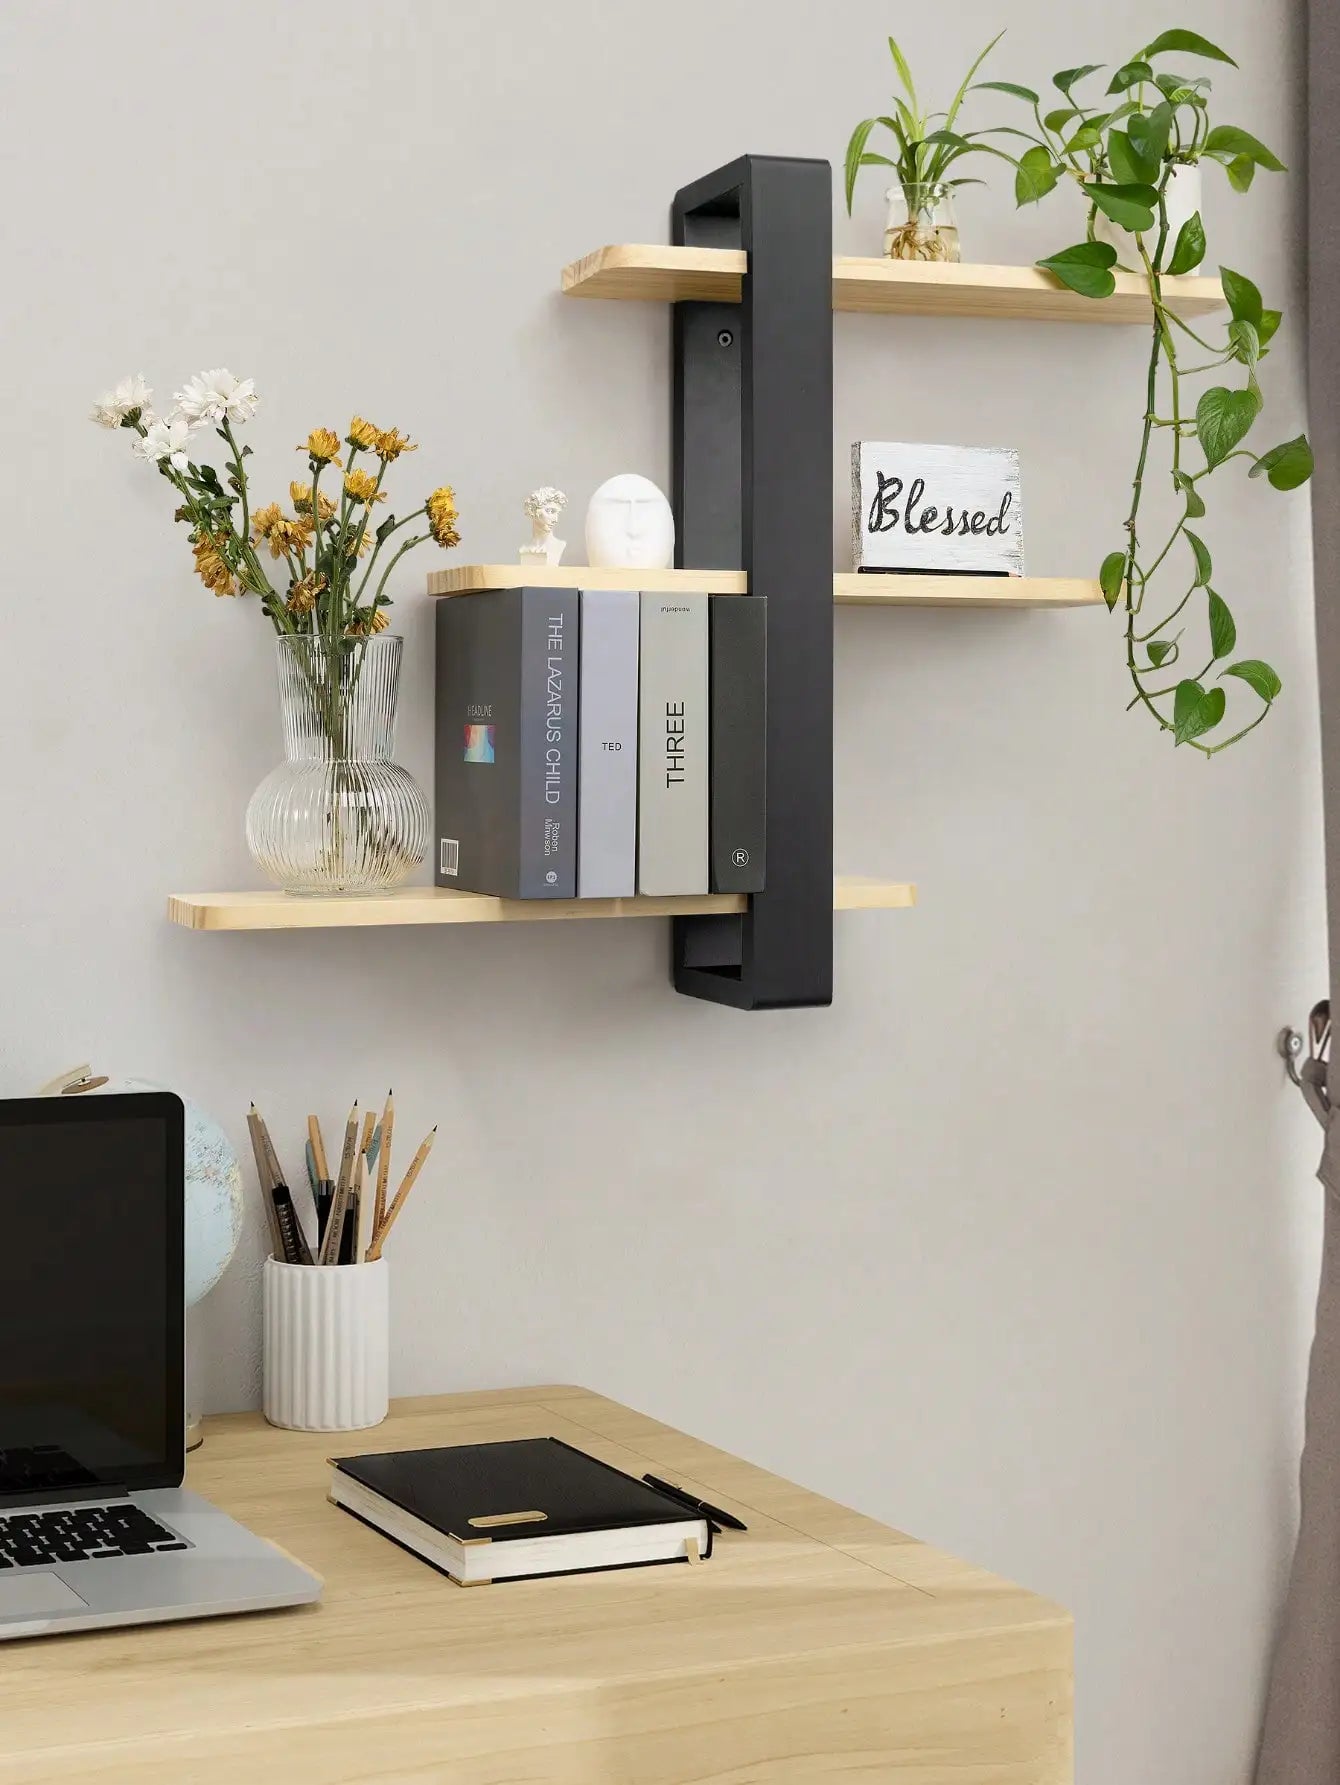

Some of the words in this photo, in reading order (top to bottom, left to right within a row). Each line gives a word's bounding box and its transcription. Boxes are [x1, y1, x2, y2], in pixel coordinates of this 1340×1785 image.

[868, 471, 1012, 536] Blessed
[548, 613, 563, 651] THE
[546, 657, 562, 743] LAZARUS
[602, 743, 622, 751] TED
[666, 701, 685, 789] THREE
[545, 748, 561, 804] CHILD
